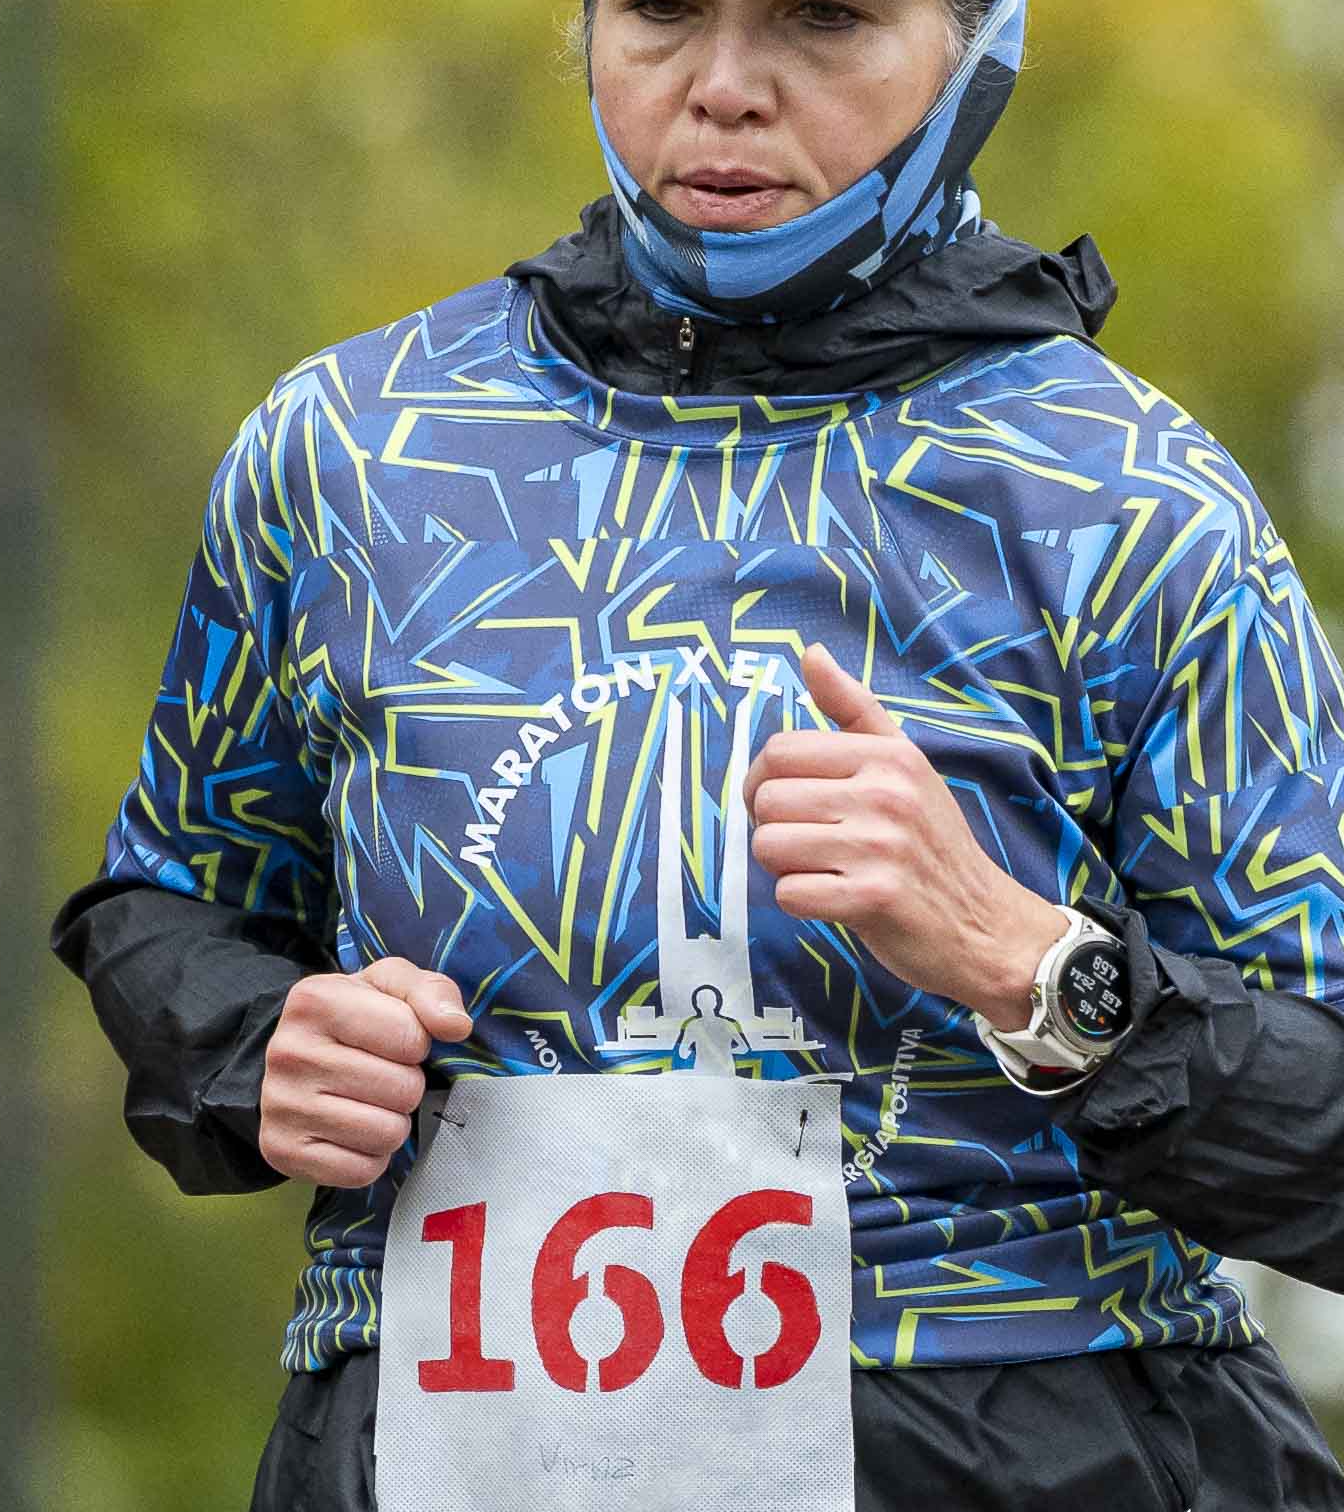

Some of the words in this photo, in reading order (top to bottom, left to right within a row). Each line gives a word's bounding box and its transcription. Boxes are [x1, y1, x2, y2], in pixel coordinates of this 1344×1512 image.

[459, 652, 657, 870] MARATÓN
[674, 645, 711, 687] X
[729, 648, 784, 697] EL
[417, 1188, 822, 1394] 166
